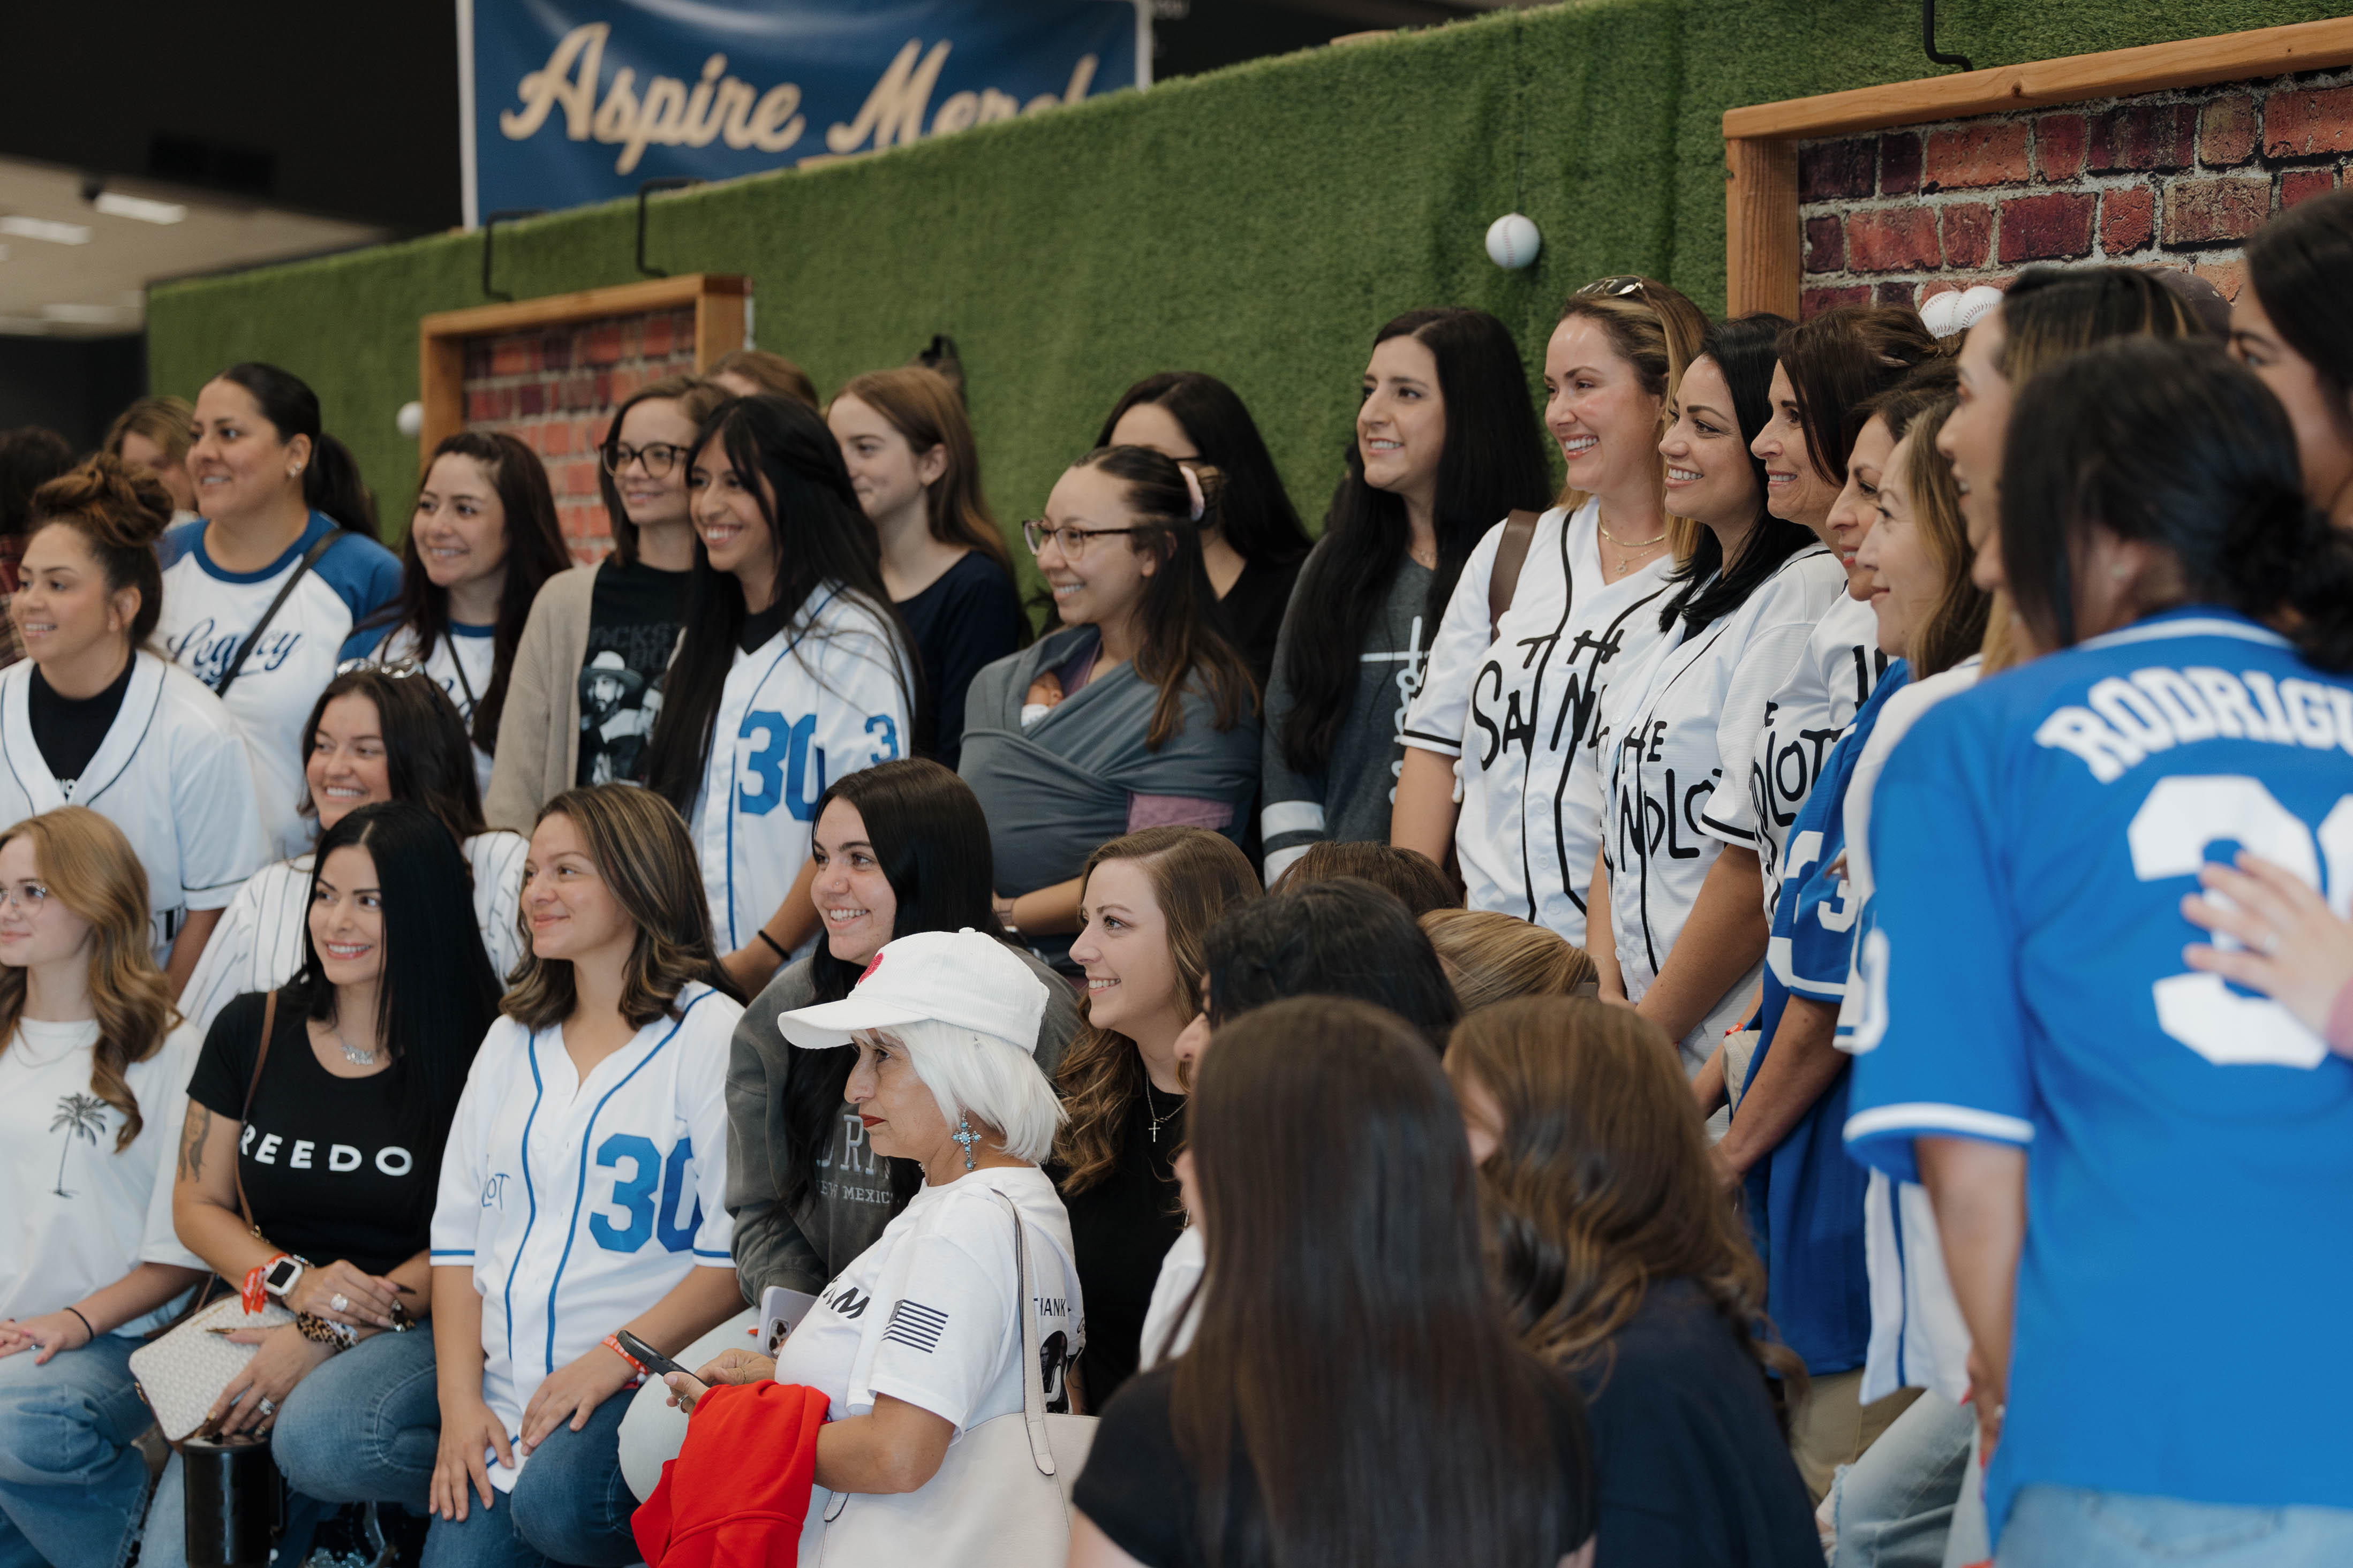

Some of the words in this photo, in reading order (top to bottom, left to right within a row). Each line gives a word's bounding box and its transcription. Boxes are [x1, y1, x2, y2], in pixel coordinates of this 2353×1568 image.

[500, 21, 807, 176] Aspire
[167, 618, 304, 679] Legcy
[738, 710, 826, 822] 30
[1619, 768, 1723, 873] NDLO
[2126, 774, 2353, 1070] 3
[589, 1132, 704, 1254] 30
[817, 1179, 839, 1199] EW
[843, 1186, 894, 1205] MEXIC
